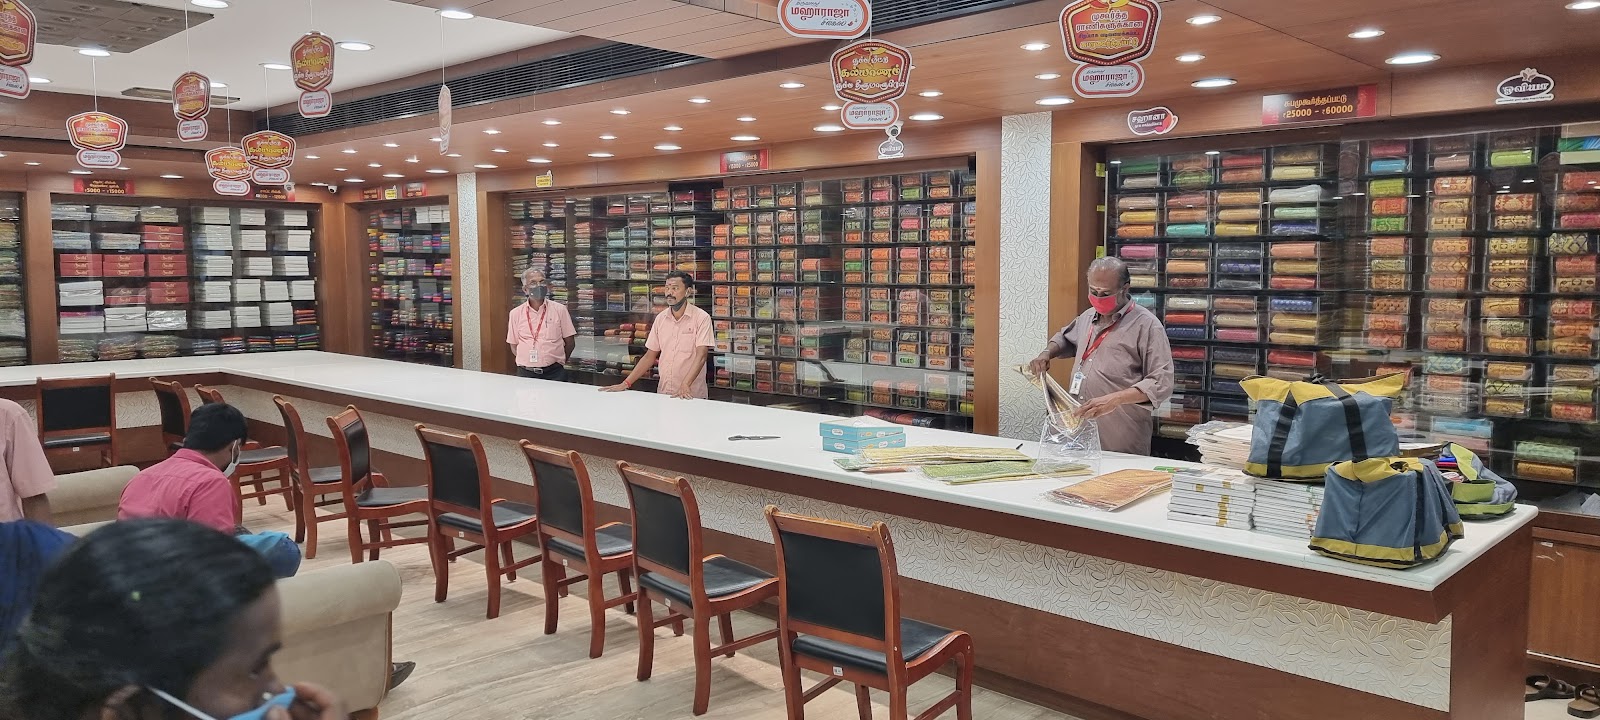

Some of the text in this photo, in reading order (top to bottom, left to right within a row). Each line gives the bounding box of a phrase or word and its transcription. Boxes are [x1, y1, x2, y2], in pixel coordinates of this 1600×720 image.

[791, 7, 850, 20] மஹாராஜா
[1076, 20, 1143, 33] ராணிகளுக்கான
[841, 64, 900, 78] கல்யாணம்
[1082, 73, 1128, 85] மஹாராஜா
[1502, 82, 1549, 96] ஓவியா
[1322, 105, 1353, 114] ₹60000
[1131, 113, 1166, 124] சஹானா
